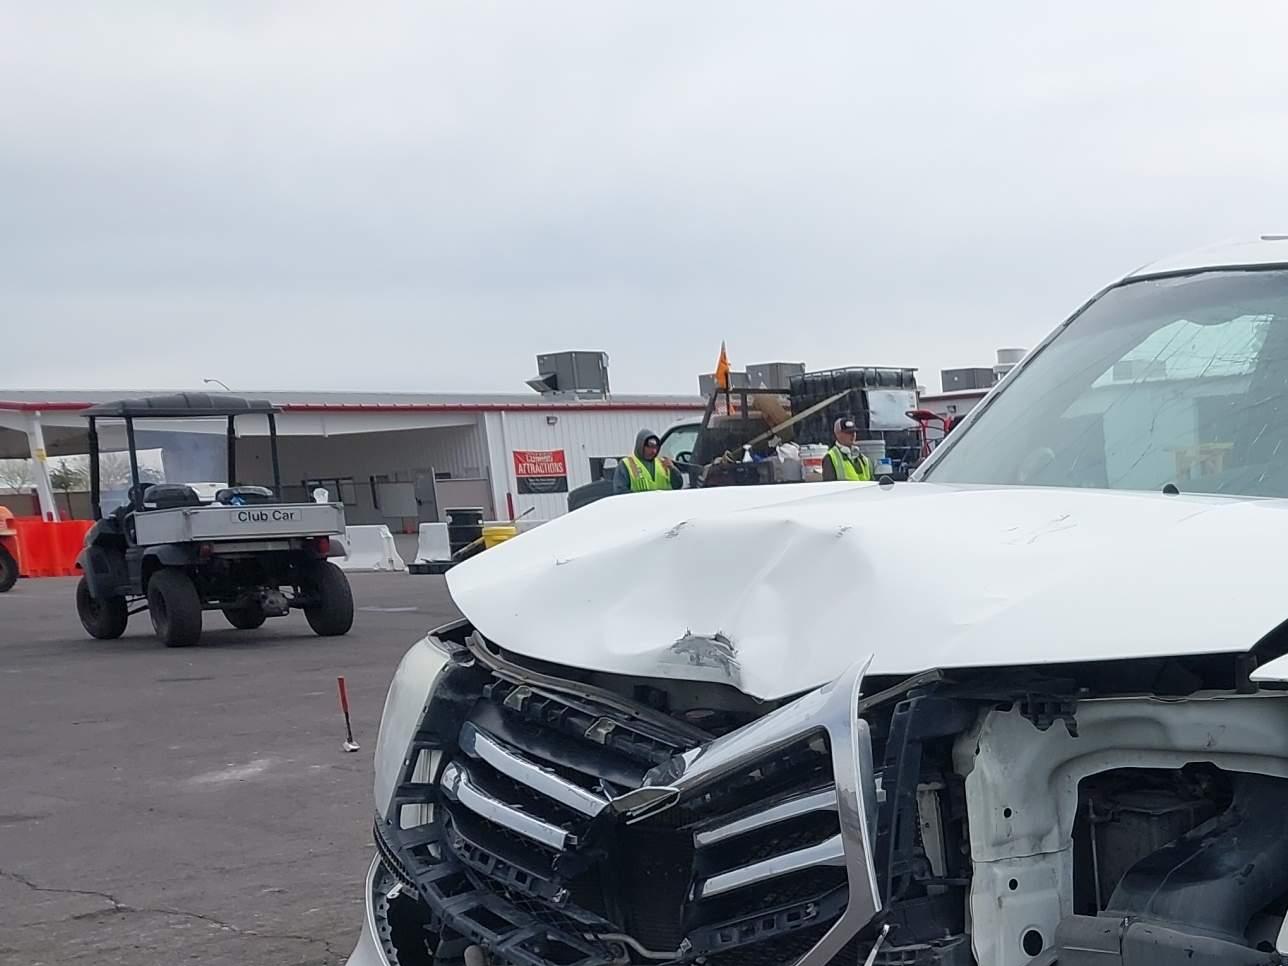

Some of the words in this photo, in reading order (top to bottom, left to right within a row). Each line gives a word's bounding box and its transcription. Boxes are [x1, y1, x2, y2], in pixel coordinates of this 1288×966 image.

[518, 462, 564, 474] ATTRACTIONS
[238, 511, 268, 521] Club
[272, 510, 294, 520] Car
